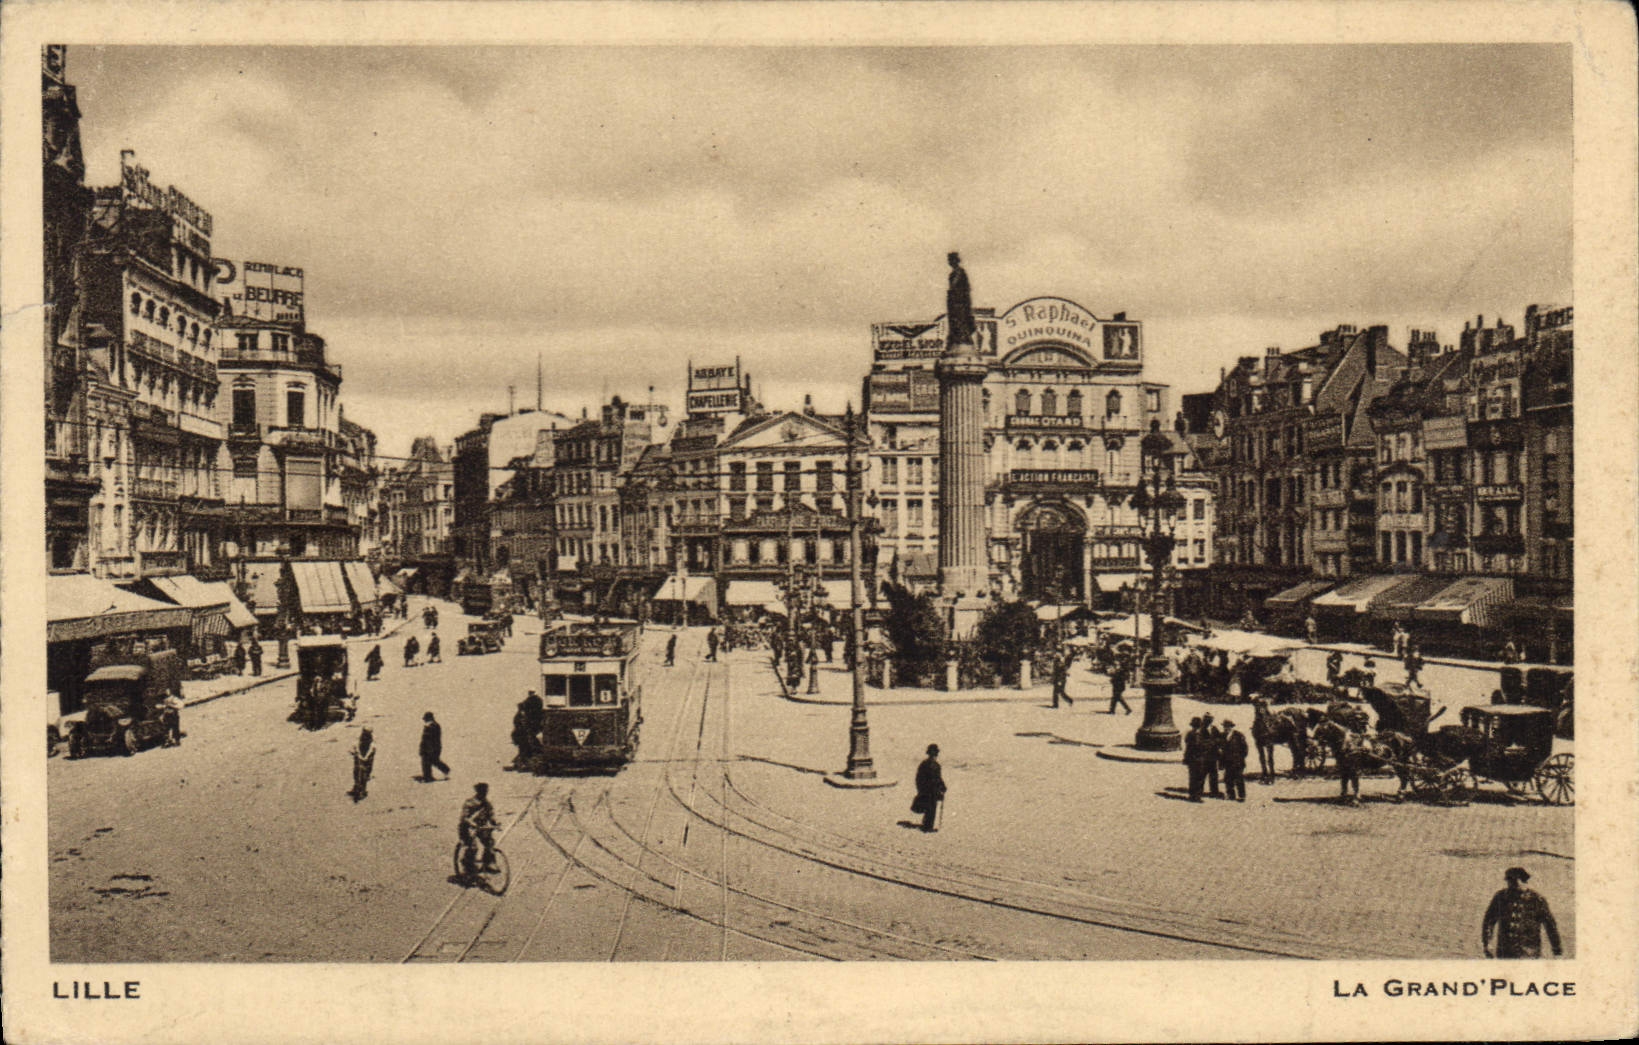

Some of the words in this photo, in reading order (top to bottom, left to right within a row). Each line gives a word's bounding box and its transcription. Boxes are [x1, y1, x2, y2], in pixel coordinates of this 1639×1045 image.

[243, 261, 304, 278] REMPLACE
[245, 286, 304, 306] BEURRE
[1023, 303, 1096, 332] Raphael
[1007, 327, 1091, 347] QUINQUINA
[695, 366, 735, 379] ABBAYE
[689, 394, 738, 409] CHAPELLERIE
[1041, 416, 1081, 426] OTARD
